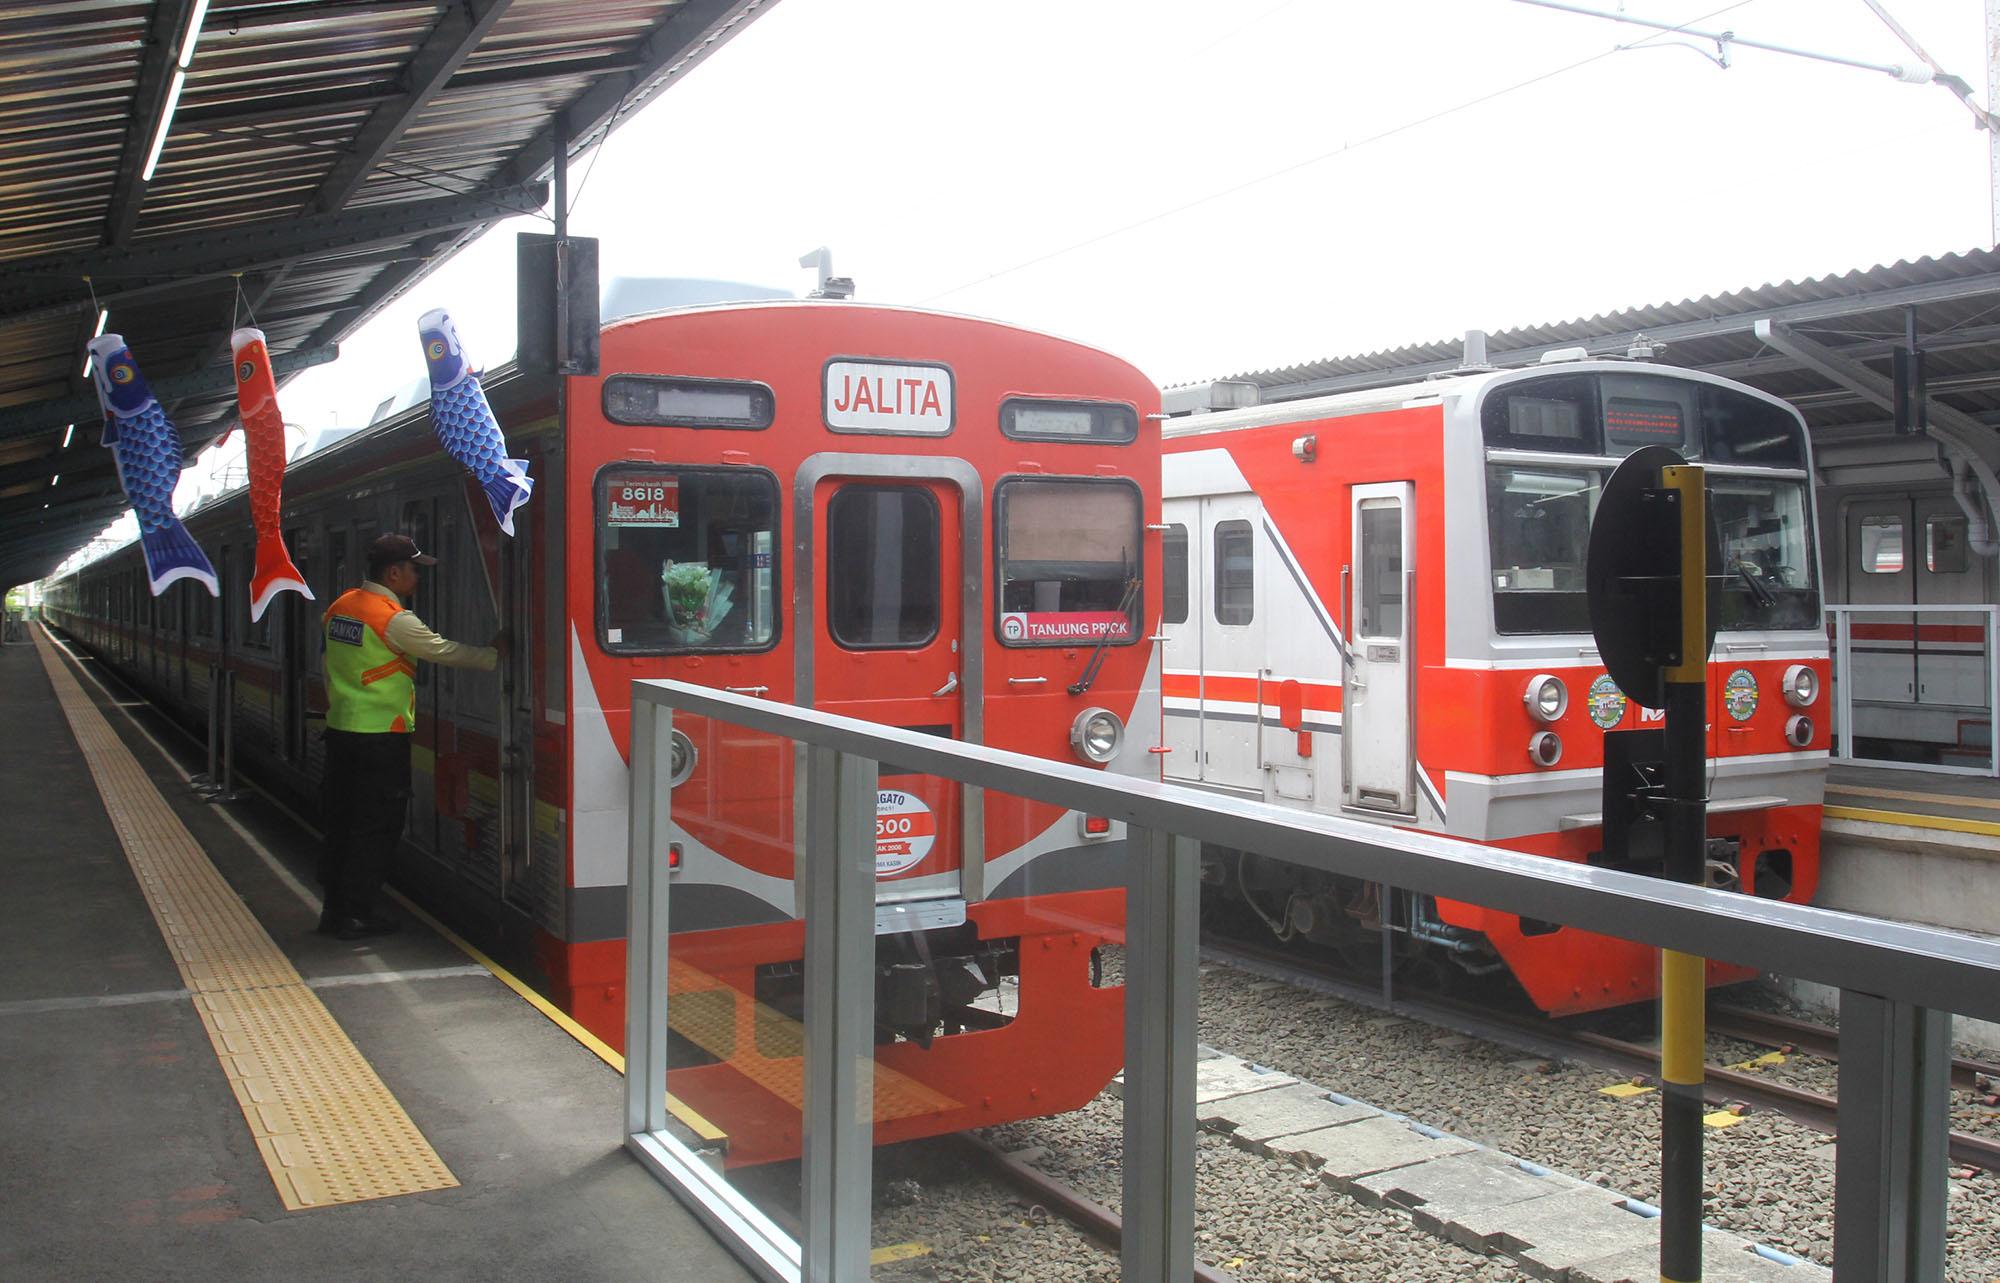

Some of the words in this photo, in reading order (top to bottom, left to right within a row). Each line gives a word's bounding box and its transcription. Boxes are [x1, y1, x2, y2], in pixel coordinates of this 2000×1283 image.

[834, 375, 942, 416] JALITA
[622, 488, 665, 501] 8618
[1007, 625, 1020, 634] TP
[1030, 623, 1089, 635] TANJUNG
